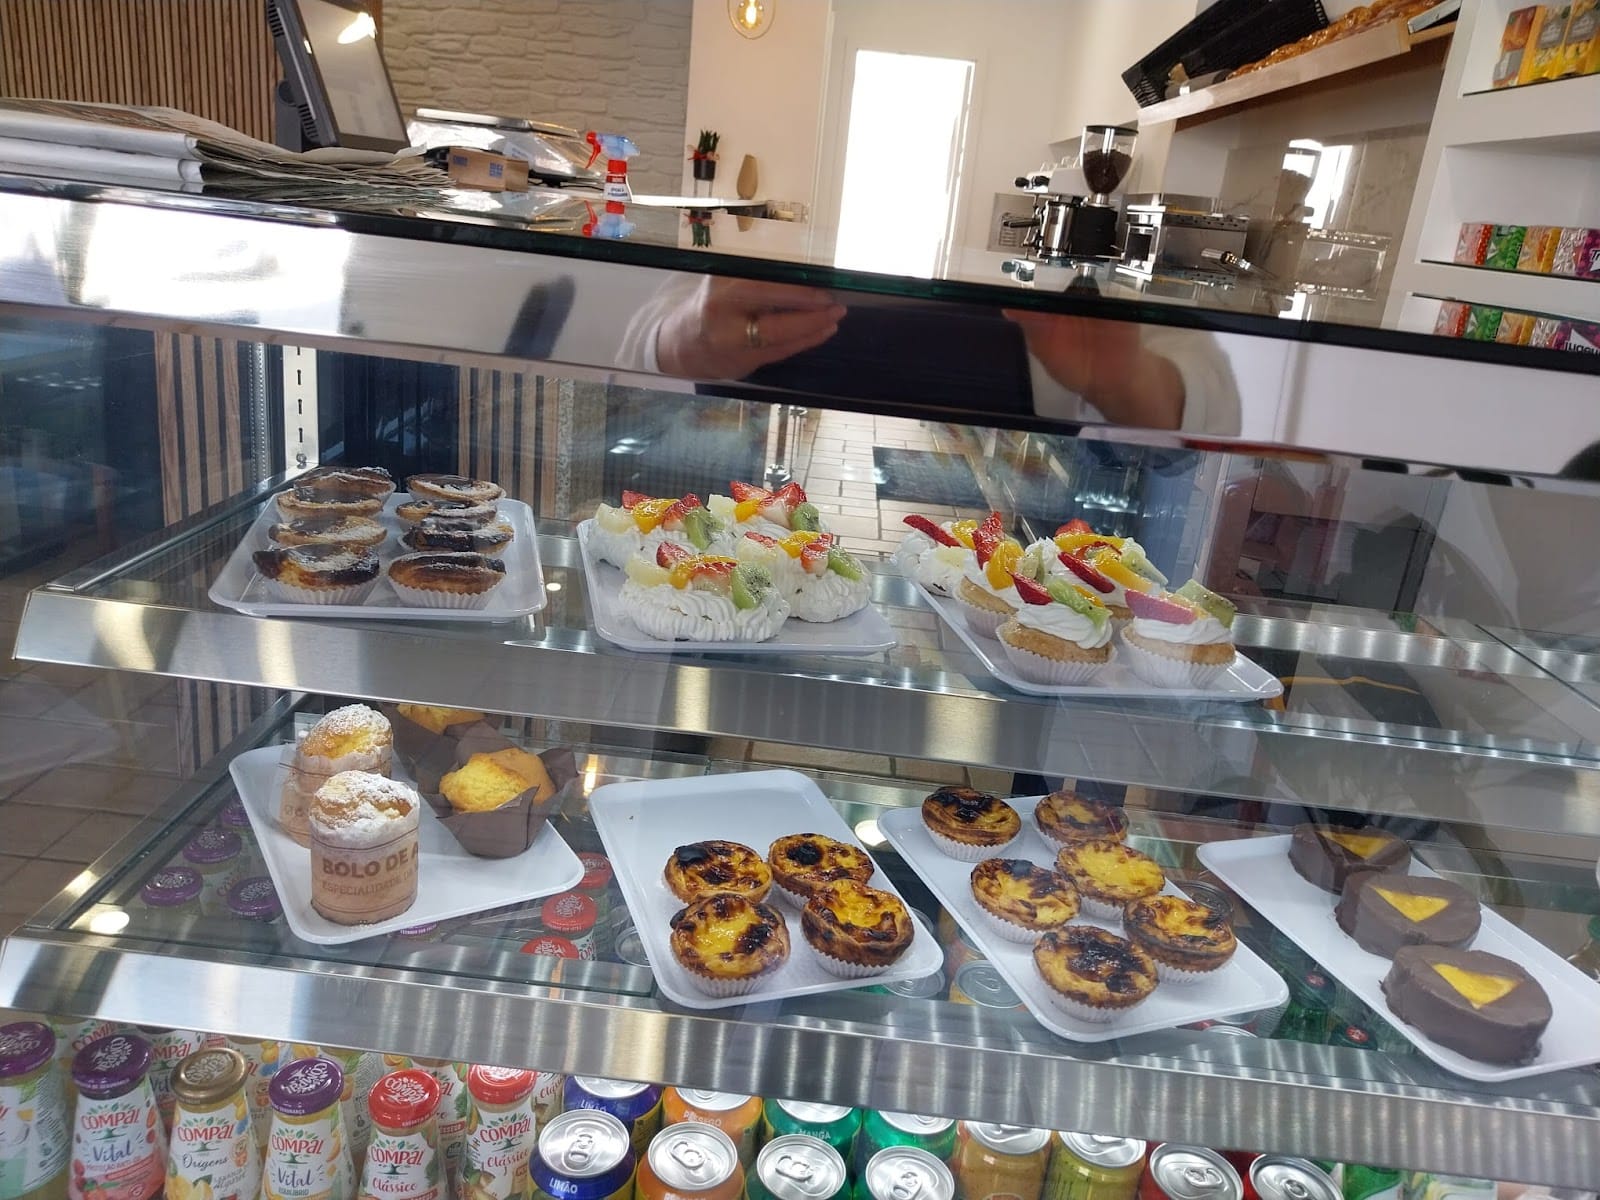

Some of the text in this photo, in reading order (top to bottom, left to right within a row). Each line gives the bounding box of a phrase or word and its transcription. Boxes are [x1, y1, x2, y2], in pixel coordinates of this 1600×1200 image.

[323, 858, 380, 878] BOLO
[386, 848, 408, 872] DE
[93, 1140, 132, 1162] Vital
[183, 1153, 228, 1172] Origens
[278, 1167, 315, 1188] Vital
[549, 1177, 578, 1194] LIMÃO
